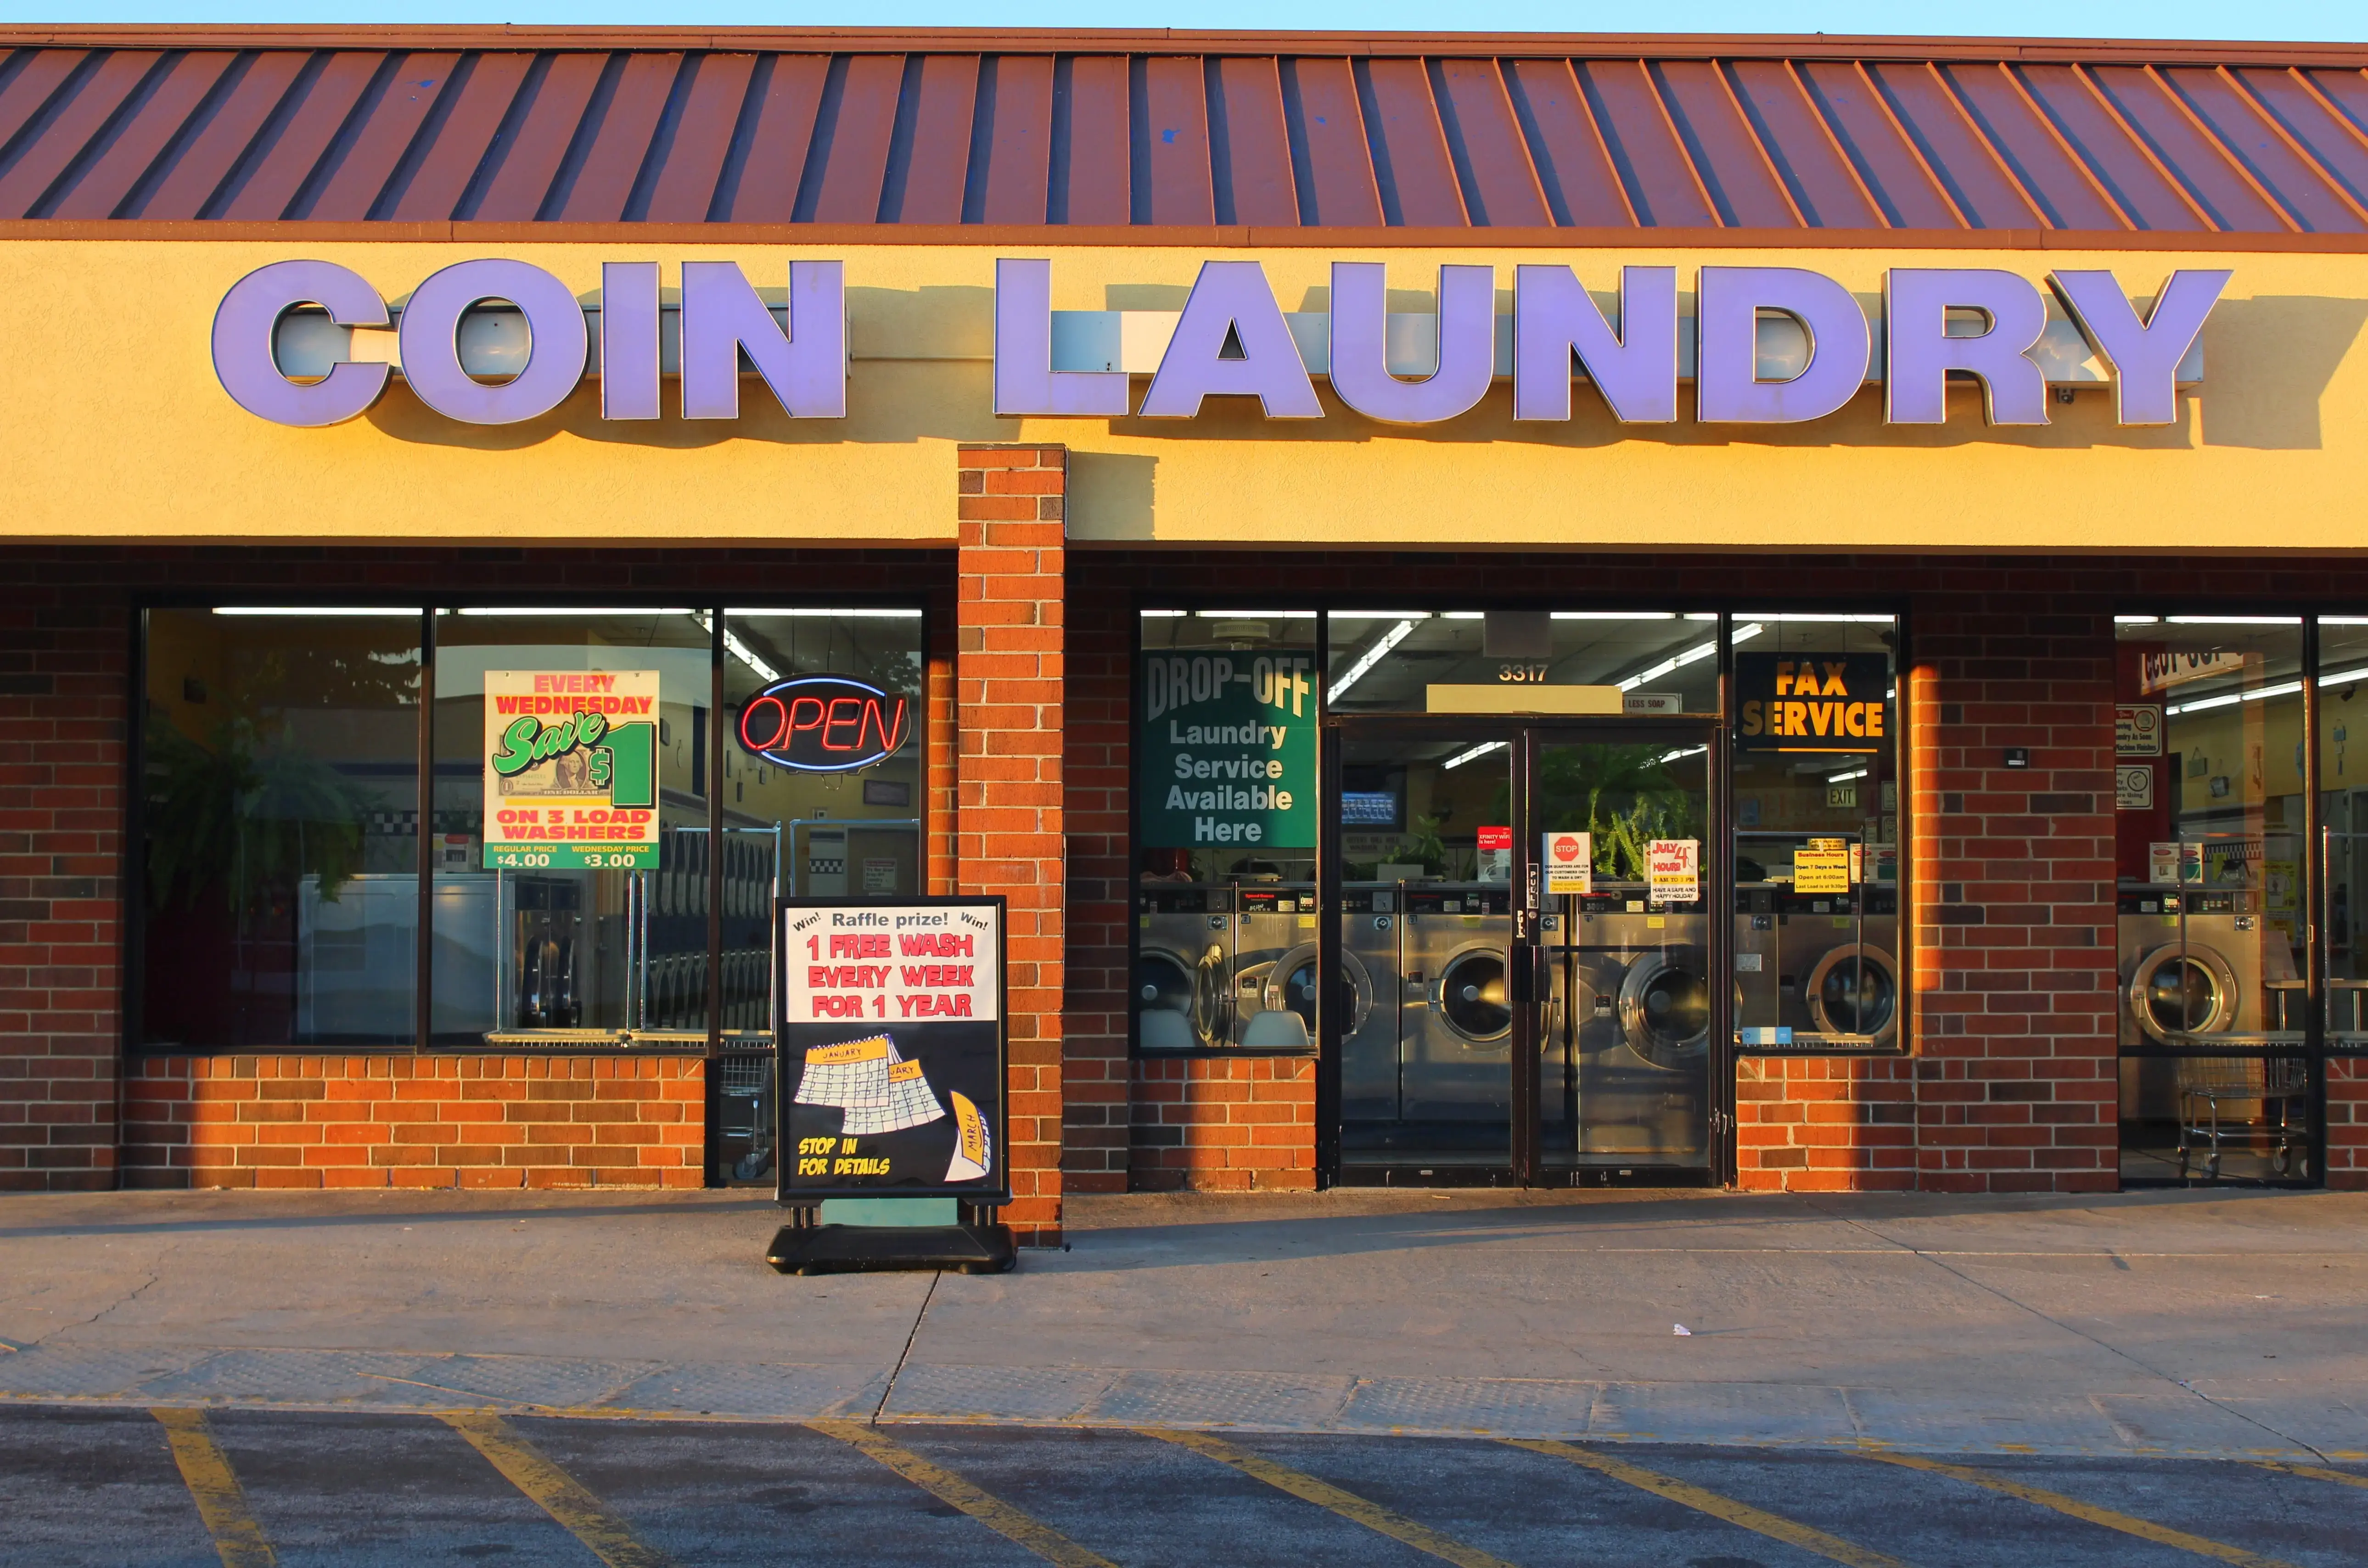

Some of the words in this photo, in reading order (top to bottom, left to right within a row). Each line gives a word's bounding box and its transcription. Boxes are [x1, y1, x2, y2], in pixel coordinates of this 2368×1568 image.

[212, 258, 846, 426] COIN
[994, 258, 2233, 424] LAUNDRY
[534, 674, 617, 692] EVERY
[1499, 665, 1549, 682] 3317
[1777, 662, 1848, 695] FAX
[1148, 657, 1309, 722] DROP-OFF
[496, 696, 654, 714] WEDNESDAY
[741, 696, 903, 750] OPEN
[1742, 700, 1883, 737] SERVICE
[492, 711, 605, 774] Save
[1170, 720, 1286, 750] Laundry
[589, 722, 652, 805] $1
[1174, 753, 1283, 778] Service
[1165, 784, 1293, 810] Available
[1830, 789, 1852, 804] EXIT
[496, 810, 539, 823] ON
[548, 810, 564, 823] 3
[574, 810, 651, 823] LOAD
[502, 826, 646, 840] WASHERS
[1195, 817, 1262, 842] Here
[1653, 843, 1678, 854] JULY
[497, 854, 550, 867] $4.00
[584, 854, 635, 867] $3.00
[1654, 862, 1681, 872] HOURS
[792, 912, 821, 932] Win!
[832, 913, 889, 927] Raffle
[896, 912, 948, 929] prize!
[960, 912, 988, 931] Win!
[807, 935, 819, 961] 1
[830, 934, 892, 959] FREE
[898, 933, 974, 958] WASH
[808, 965, 892, 988] EVERY
[900, 965, 974, 987] WEEK
[812, 995, 864, 1018] FOR
[872, 995, 885, 1018] 1
[896, 994, 972, 1018] YEAR
[822, 1047, 862, 1059] JANUARY
[967, 1114, 976, 1151] MARCH
[798, 1137, 836, 1155] STOP
[841, 1138, 858, 1154] IN
[798, 1158, 828, 1176] FOR
[833, 1158, 890, 1176] DETAILS
